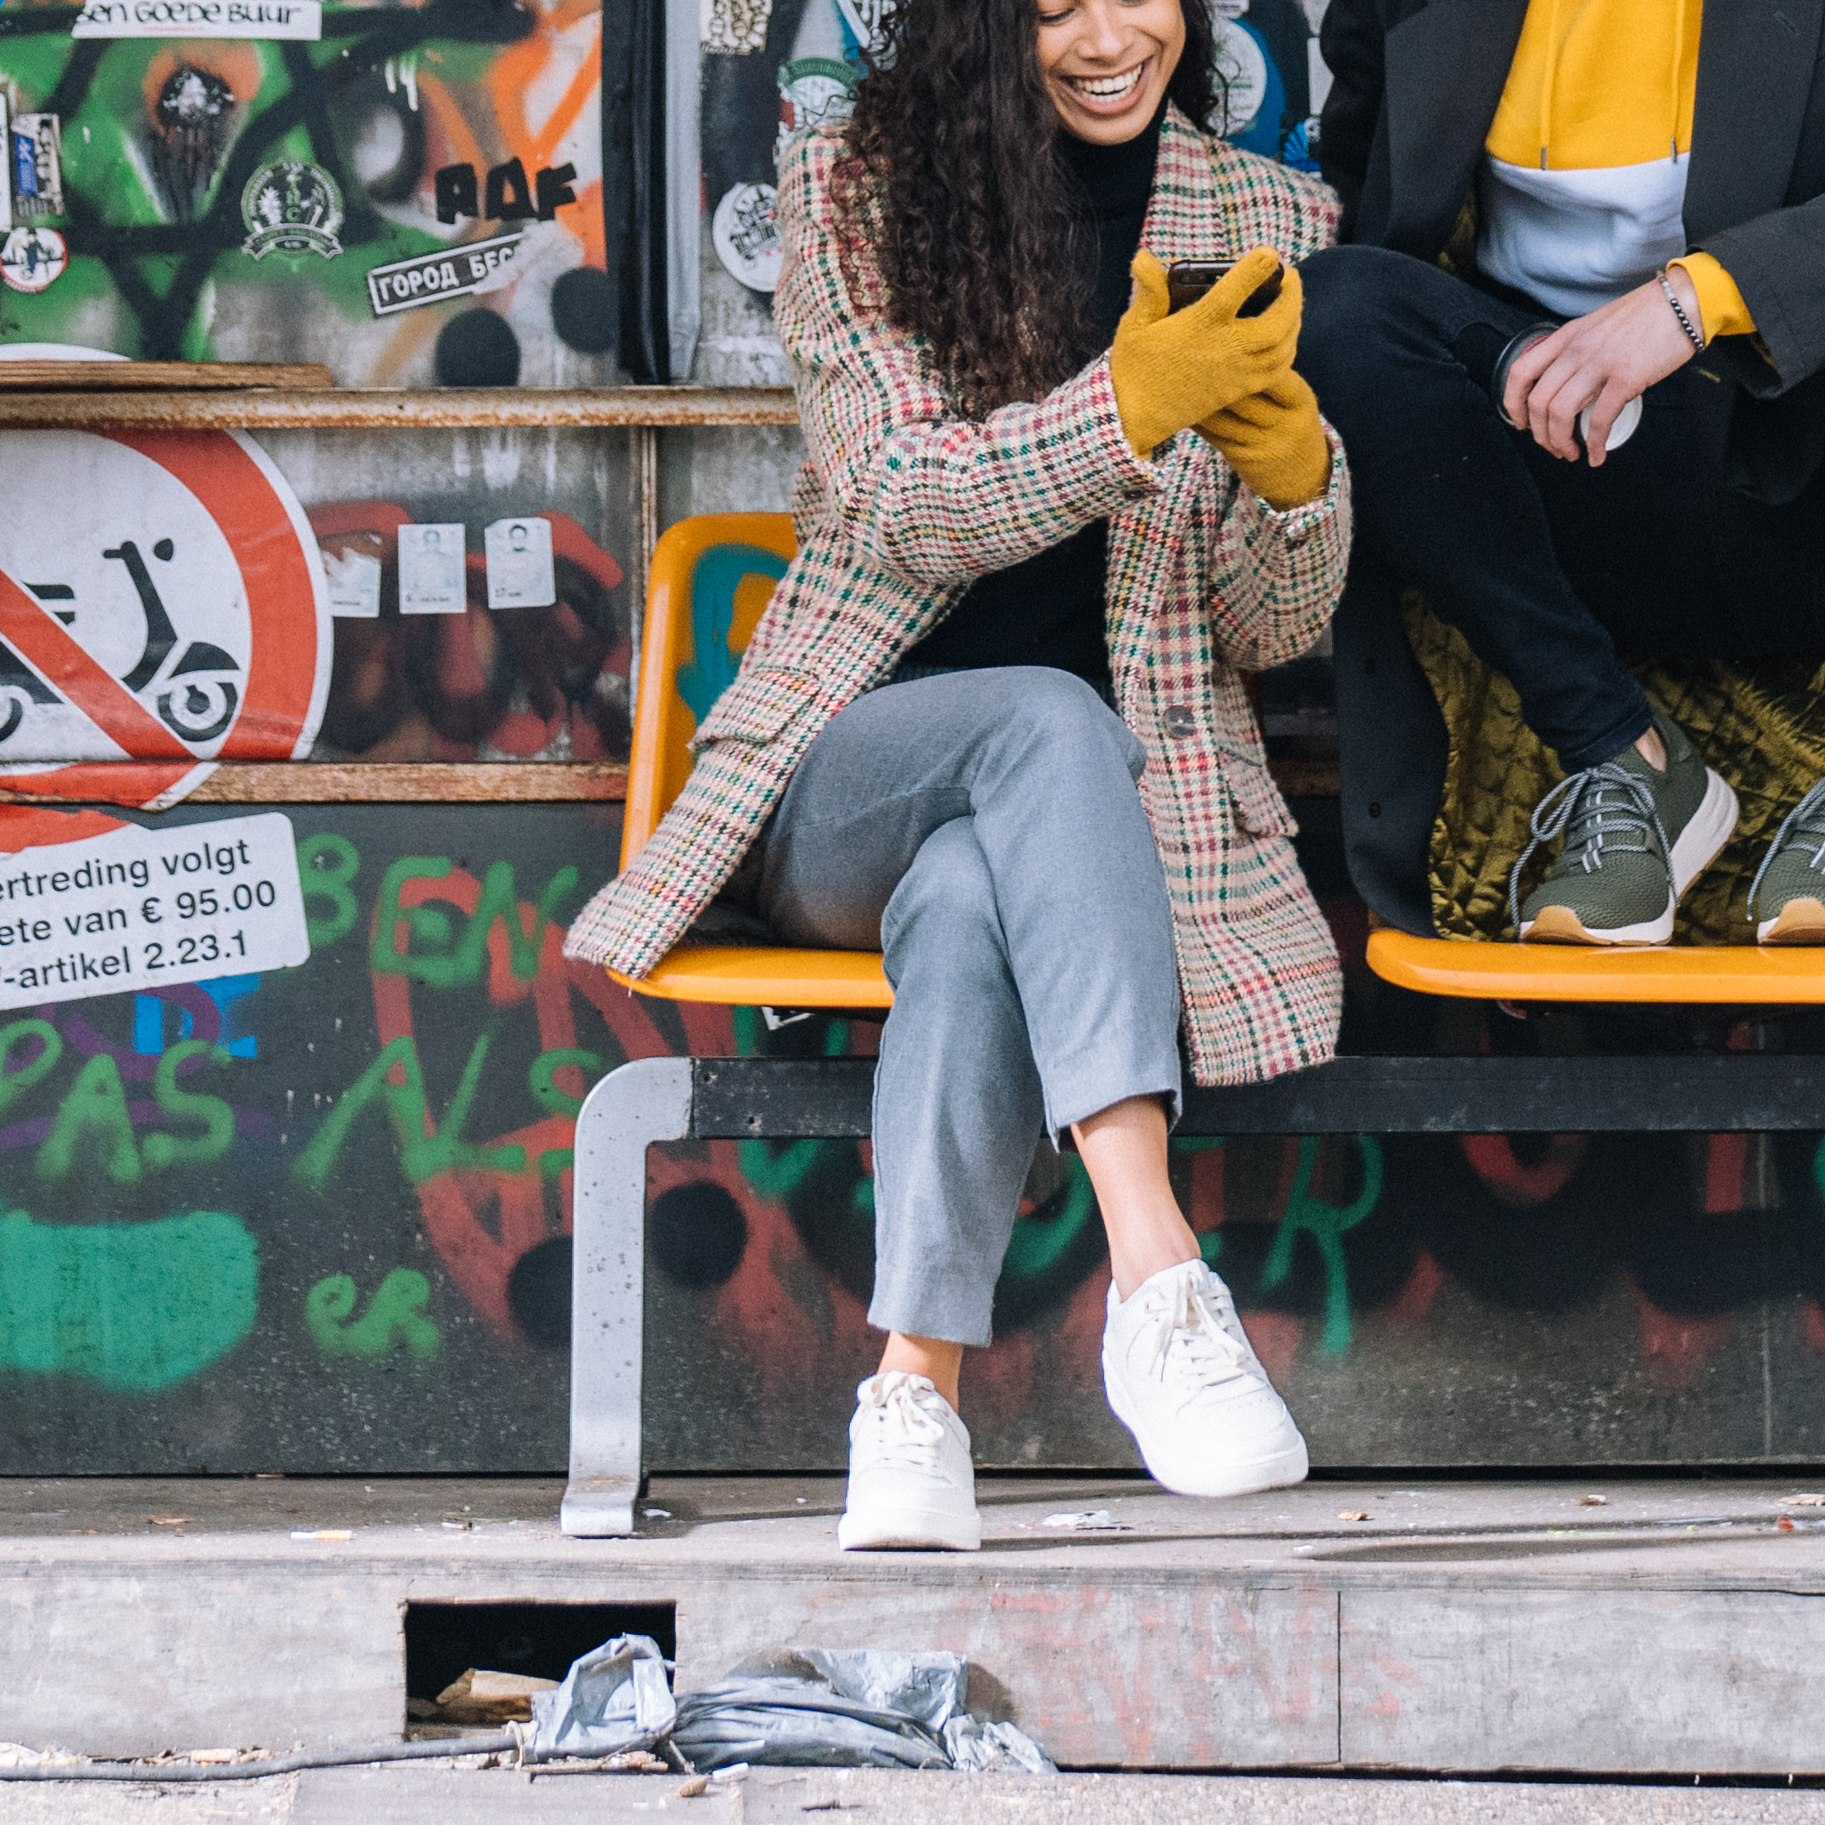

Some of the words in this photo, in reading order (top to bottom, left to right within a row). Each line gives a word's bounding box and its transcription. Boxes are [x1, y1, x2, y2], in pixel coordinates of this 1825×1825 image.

[378, 266, 460, 302] ГОРОД
[467, 242, 522, 280] БЕС
[160, 837, 252, 882] volgt
[65, 908, 128, 938] van
[140, 896, 164, 927] €
[177, 880, 278, 922] 95.00
[144, 929, 250, 972] 2.23.1
